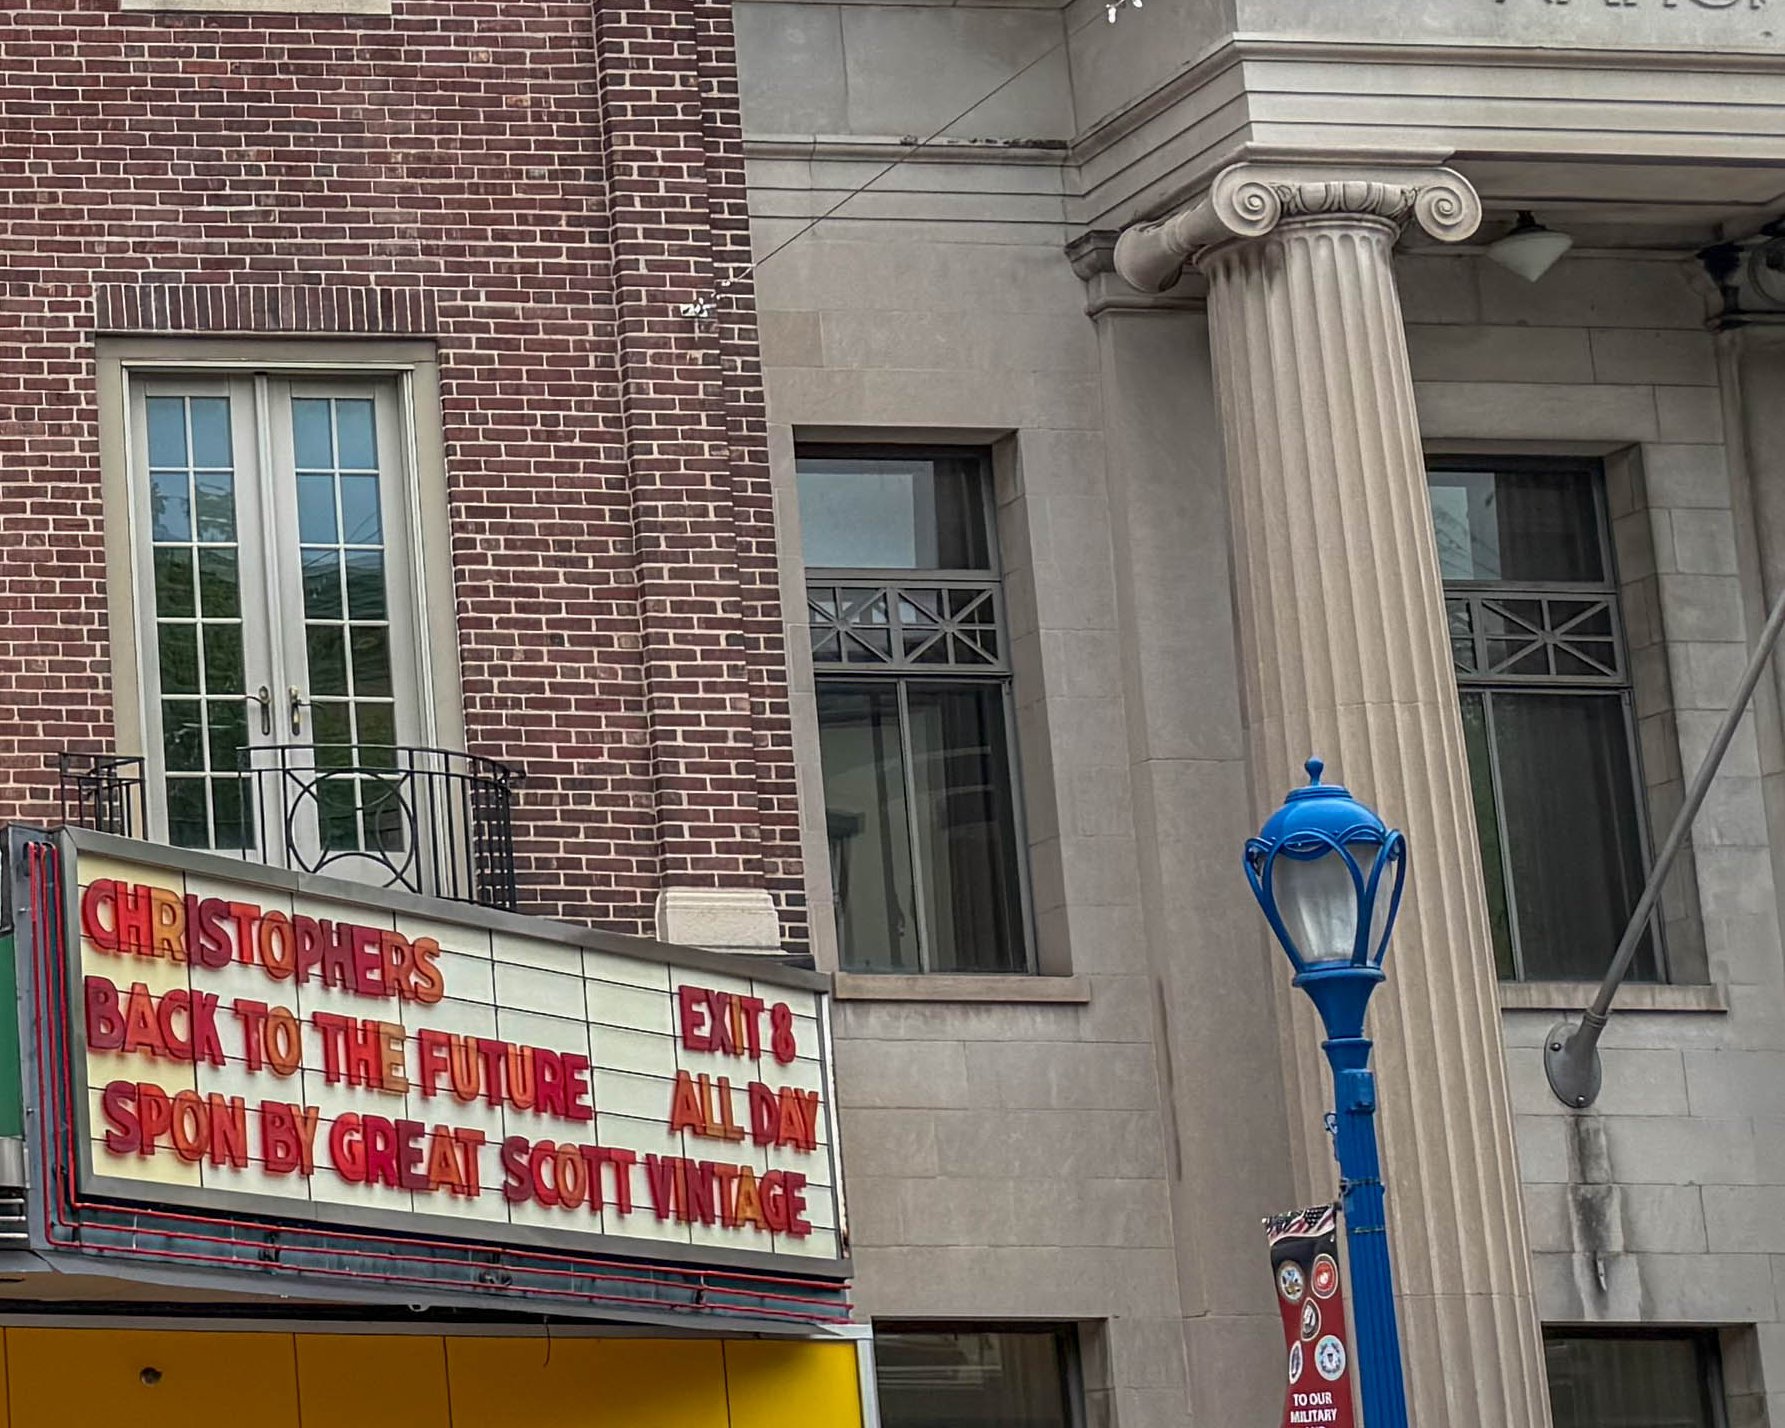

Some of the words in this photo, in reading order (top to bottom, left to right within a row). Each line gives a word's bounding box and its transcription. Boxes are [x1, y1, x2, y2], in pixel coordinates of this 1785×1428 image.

[82, 878, 444, 1003] CHRISTOPHERS
[85, 975, 226, 1066] BACK
[234, 998, 302, 1076] TO
[312, 1011, 409, 1094] THE
[418, 1028, 593, 1121] FUTURE
[678, 984, 764, 1059] EXIT
[770, 1002, 796, 1063] 8
[670, 1069, 745, 1141] ALL
[748, 1081, 819, 1151] DAY
[103, 1081, 248, 1168] SPON
[261, 1100, 320, 1175] BY
[330, 1112, 486, 1197] GREAT
[501, 1135, 636, 1214] SCOTT
[646, 1153, 812, 1236] VINTAGE
[1290, 1408, 1337, 1423] MILITARY
[1293, 1393, 1307, 1406] TO
[1309, 1392, 1332, 1406] OUR
